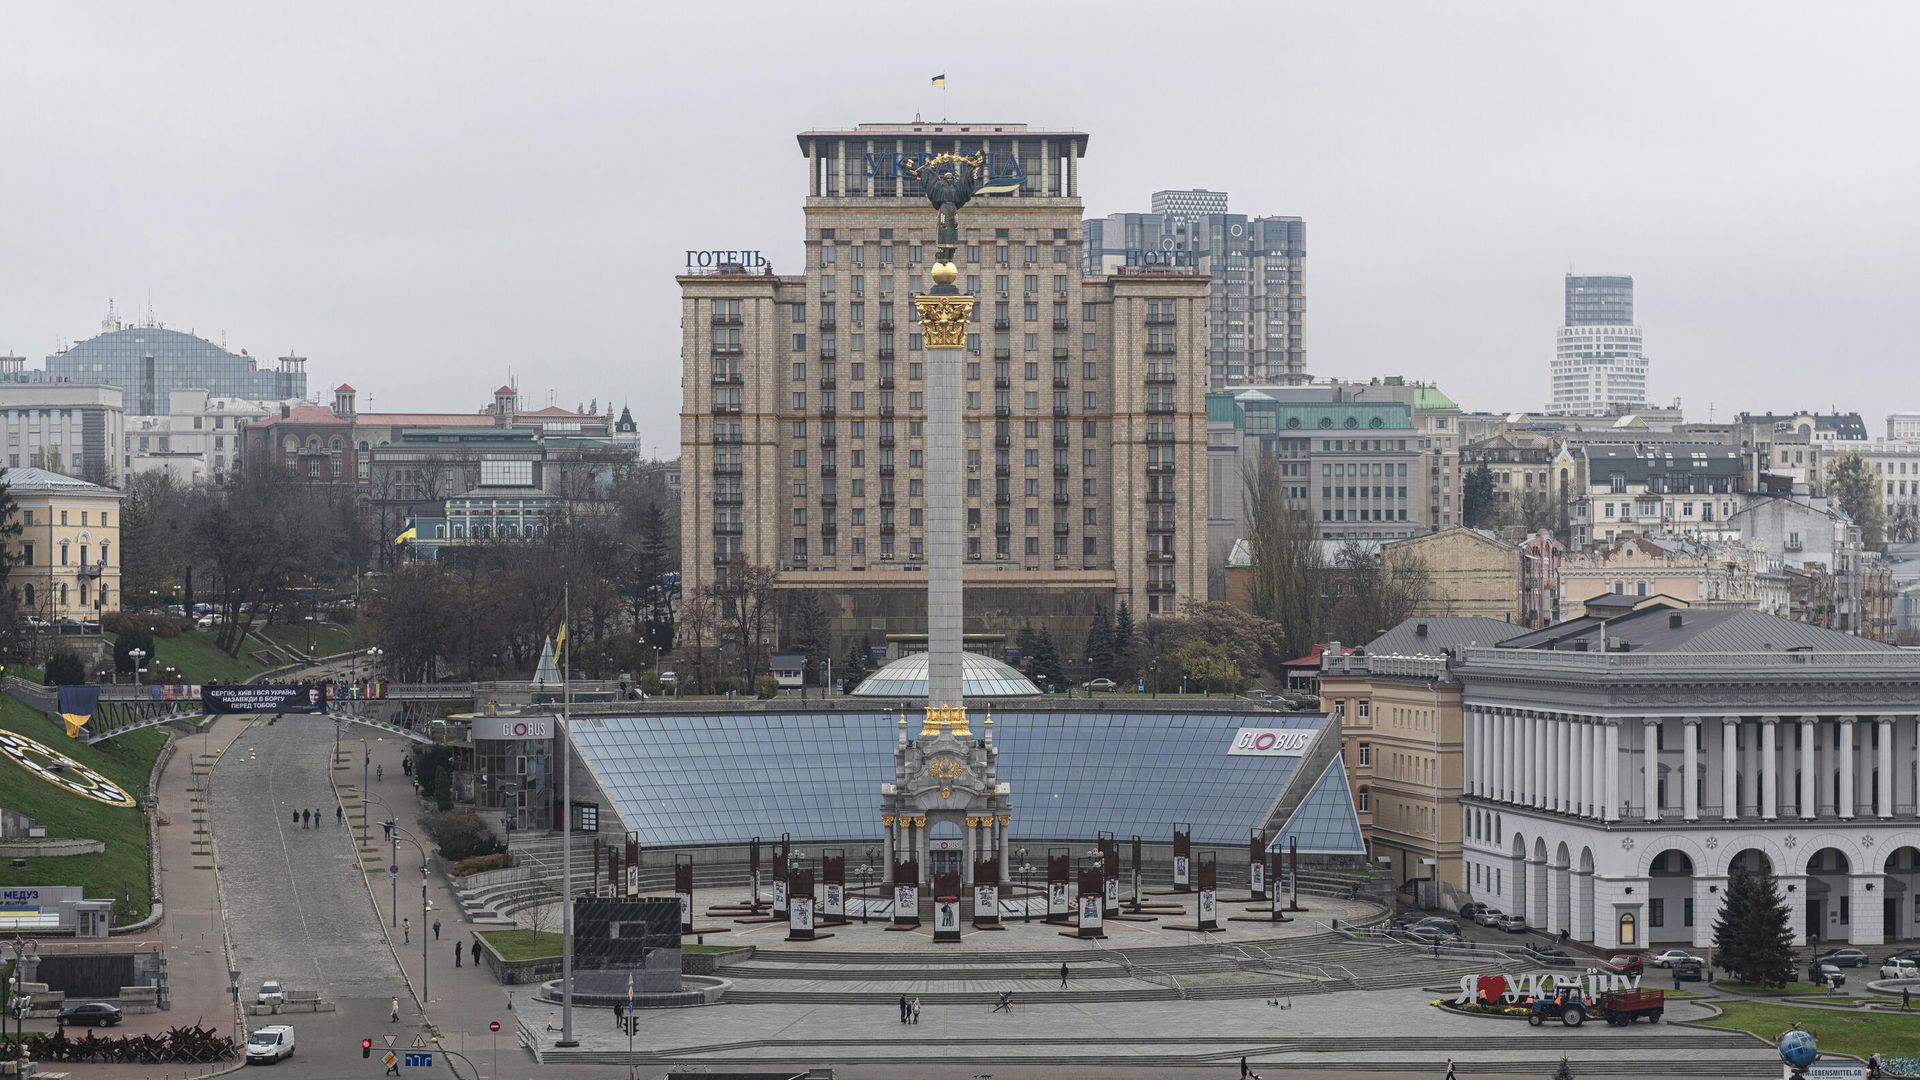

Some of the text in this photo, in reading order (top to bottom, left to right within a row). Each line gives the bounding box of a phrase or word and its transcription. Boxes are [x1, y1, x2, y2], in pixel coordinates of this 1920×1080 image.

[686, 250, 766, 268] ГОТЕЛЬ
[1126, 250, 1199, 267] HOTEL
[503, 722, 545, 736] GLOBUS
[1238, 732, 1308, 751] GLOBUS
[4, 890, 39, 900] МЕДУЗ
[1455, 974, 1479, 1005] Я
